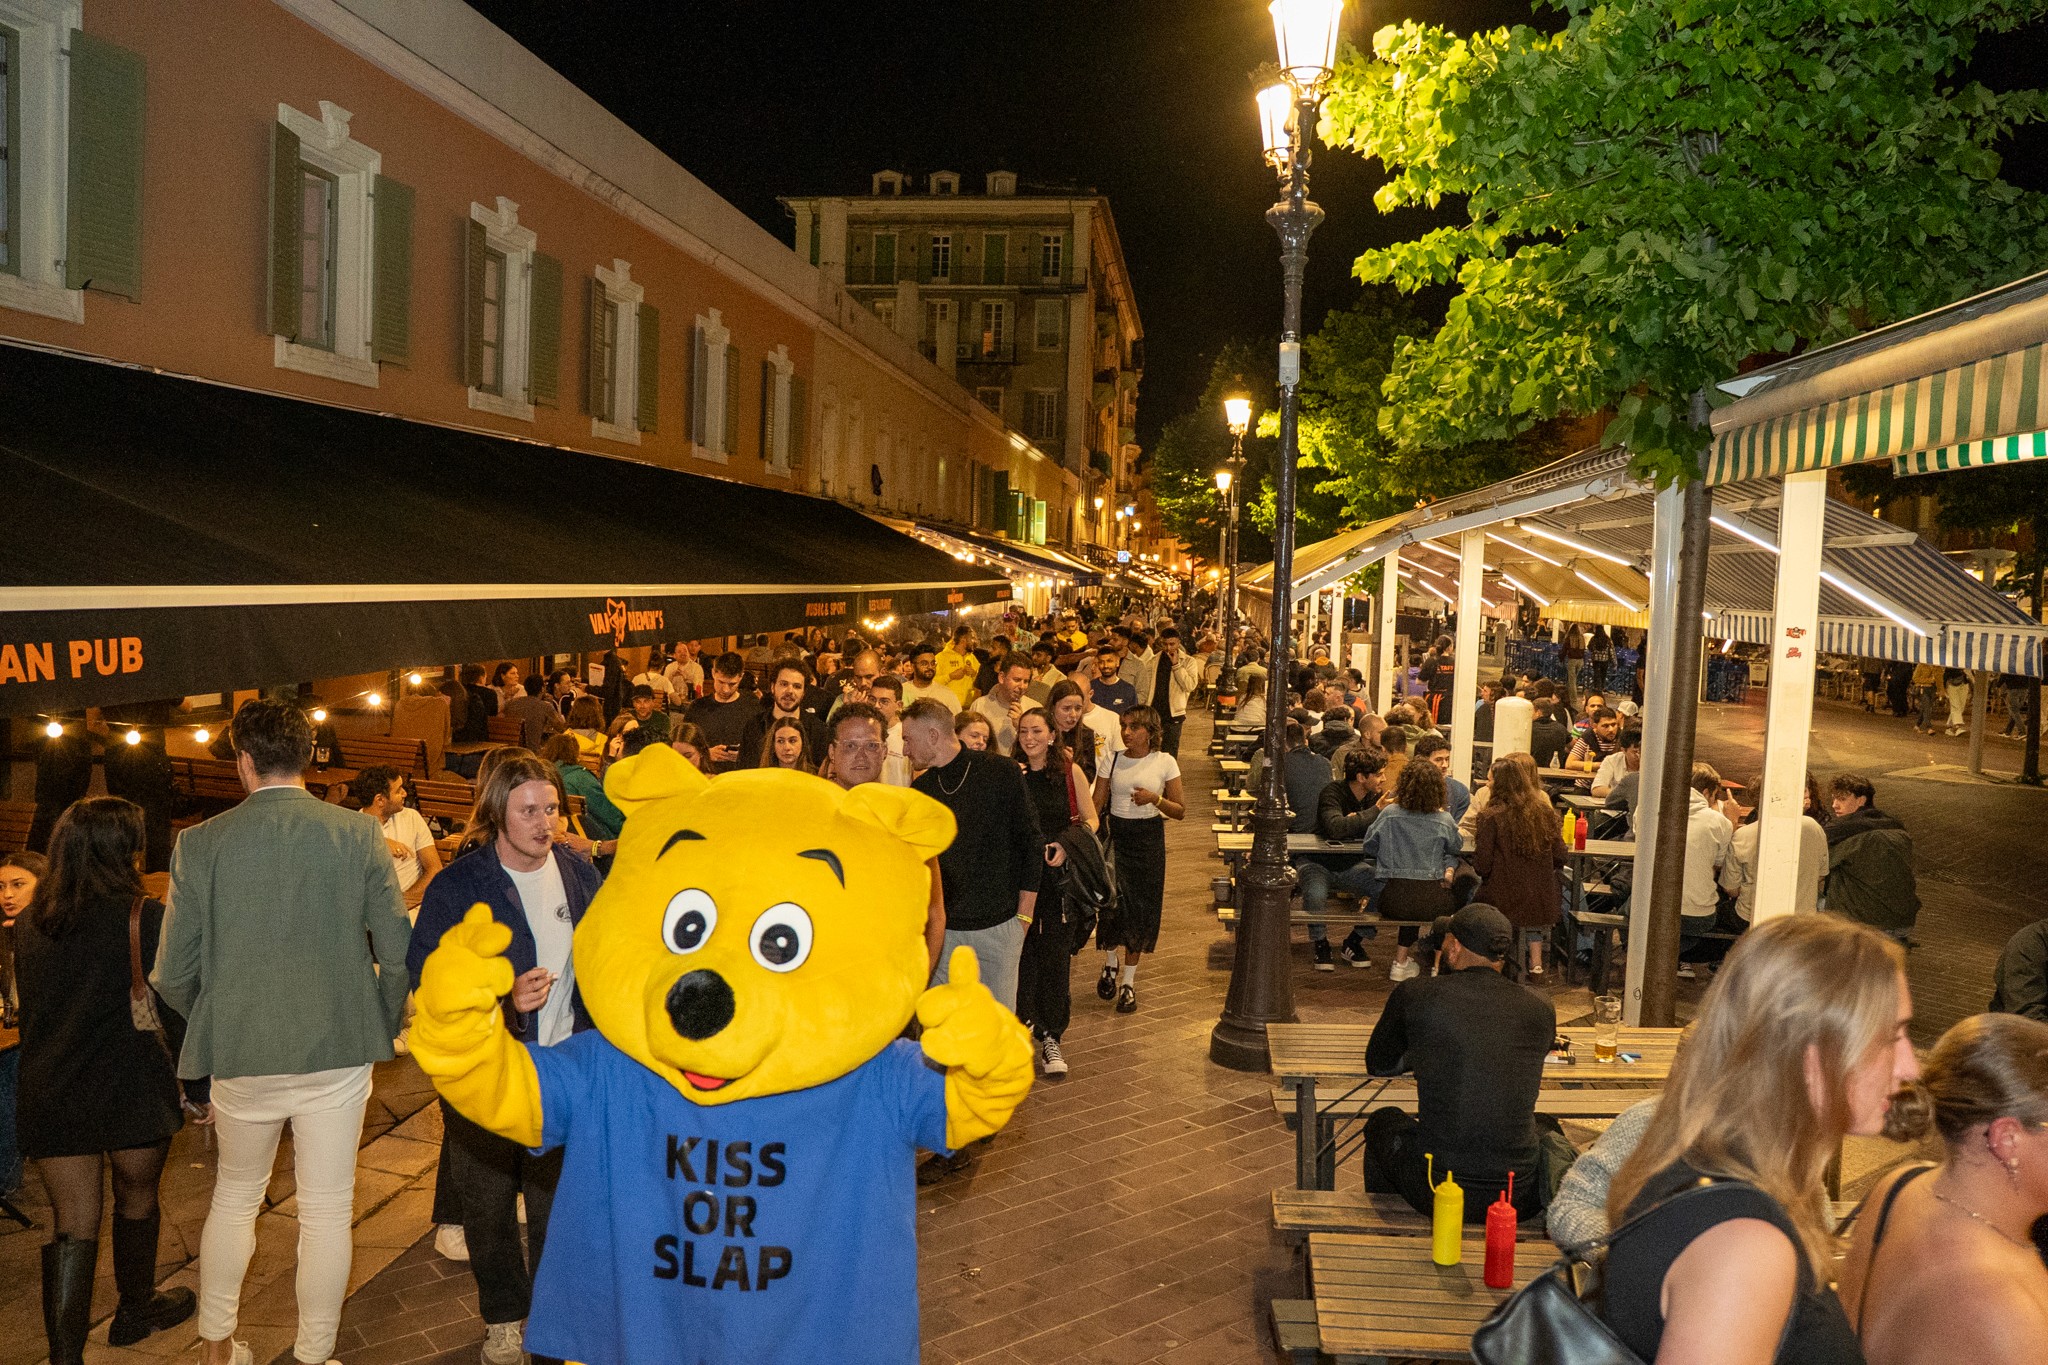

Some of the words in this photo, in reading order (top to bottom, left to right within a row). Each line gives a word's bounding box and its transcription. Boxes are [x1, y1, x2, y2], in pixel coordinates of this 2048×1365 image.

[68, 636, 144, 679] PUB
[666, 1134, 787, 1187] KISS
[683, 1190, 757, 1238] OR
[653, 1234, 793, 1291] SLAP
